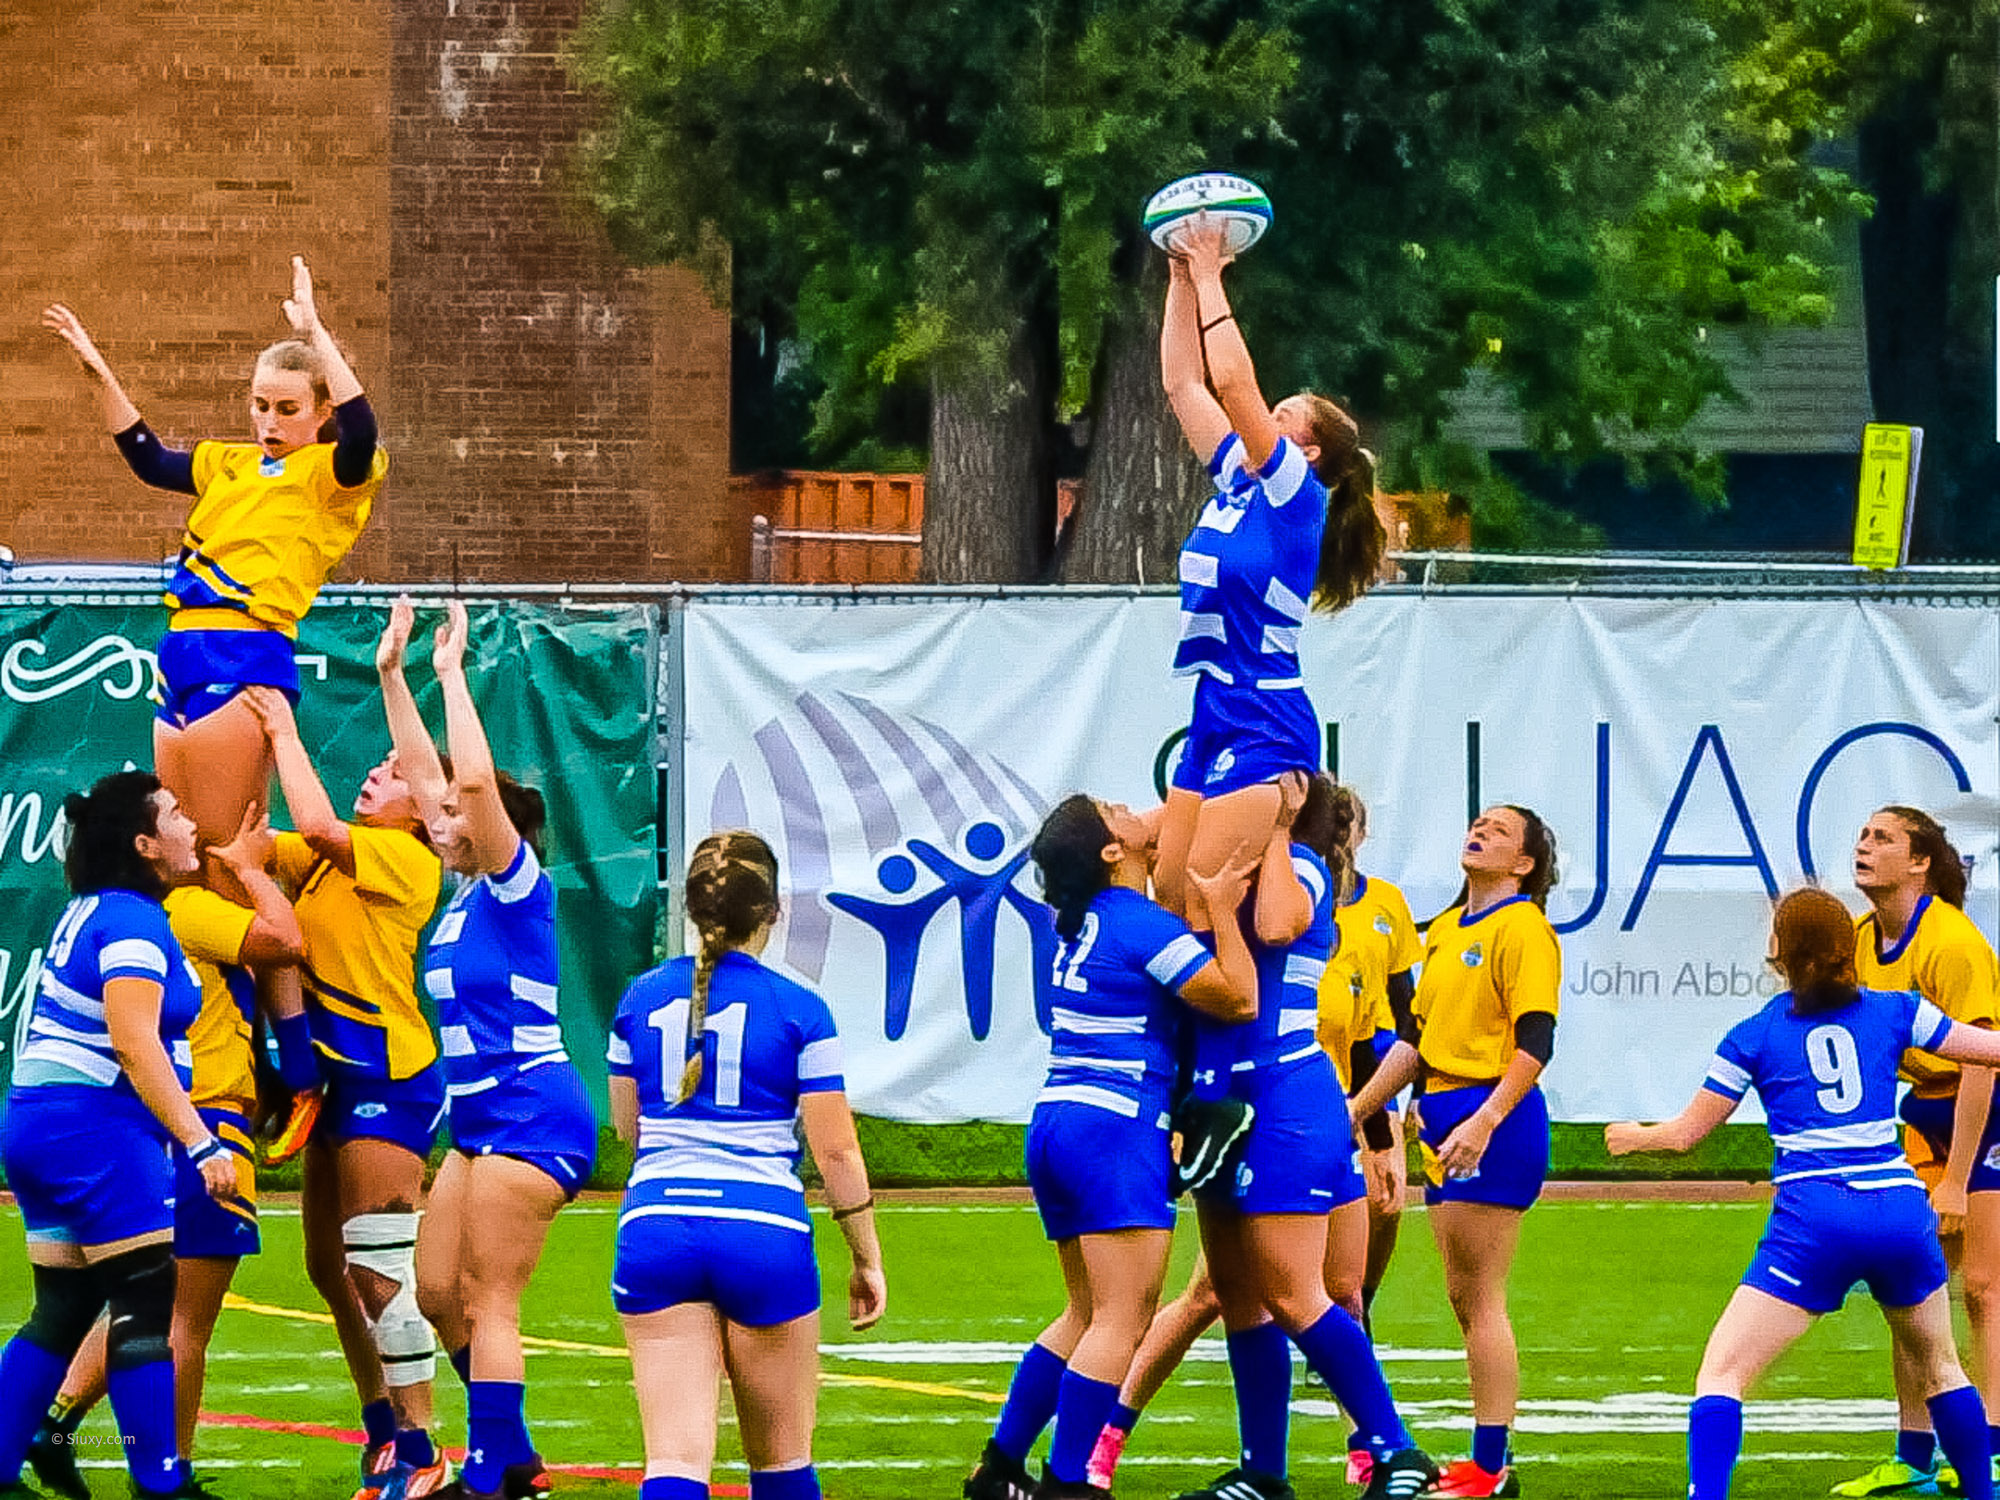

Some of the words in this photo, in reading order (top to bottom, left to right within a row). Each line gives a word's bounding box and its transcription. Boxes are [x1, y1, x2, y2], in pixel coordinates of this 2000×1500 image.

[1153, 721, 1975, 933] JAC
[1569, 960, 1660, 996] John
[1672, 961, 1783, 997] Abbo
[647, 997, 747, 1107] 11
[1806, 1024, 1863, 1114] 9
